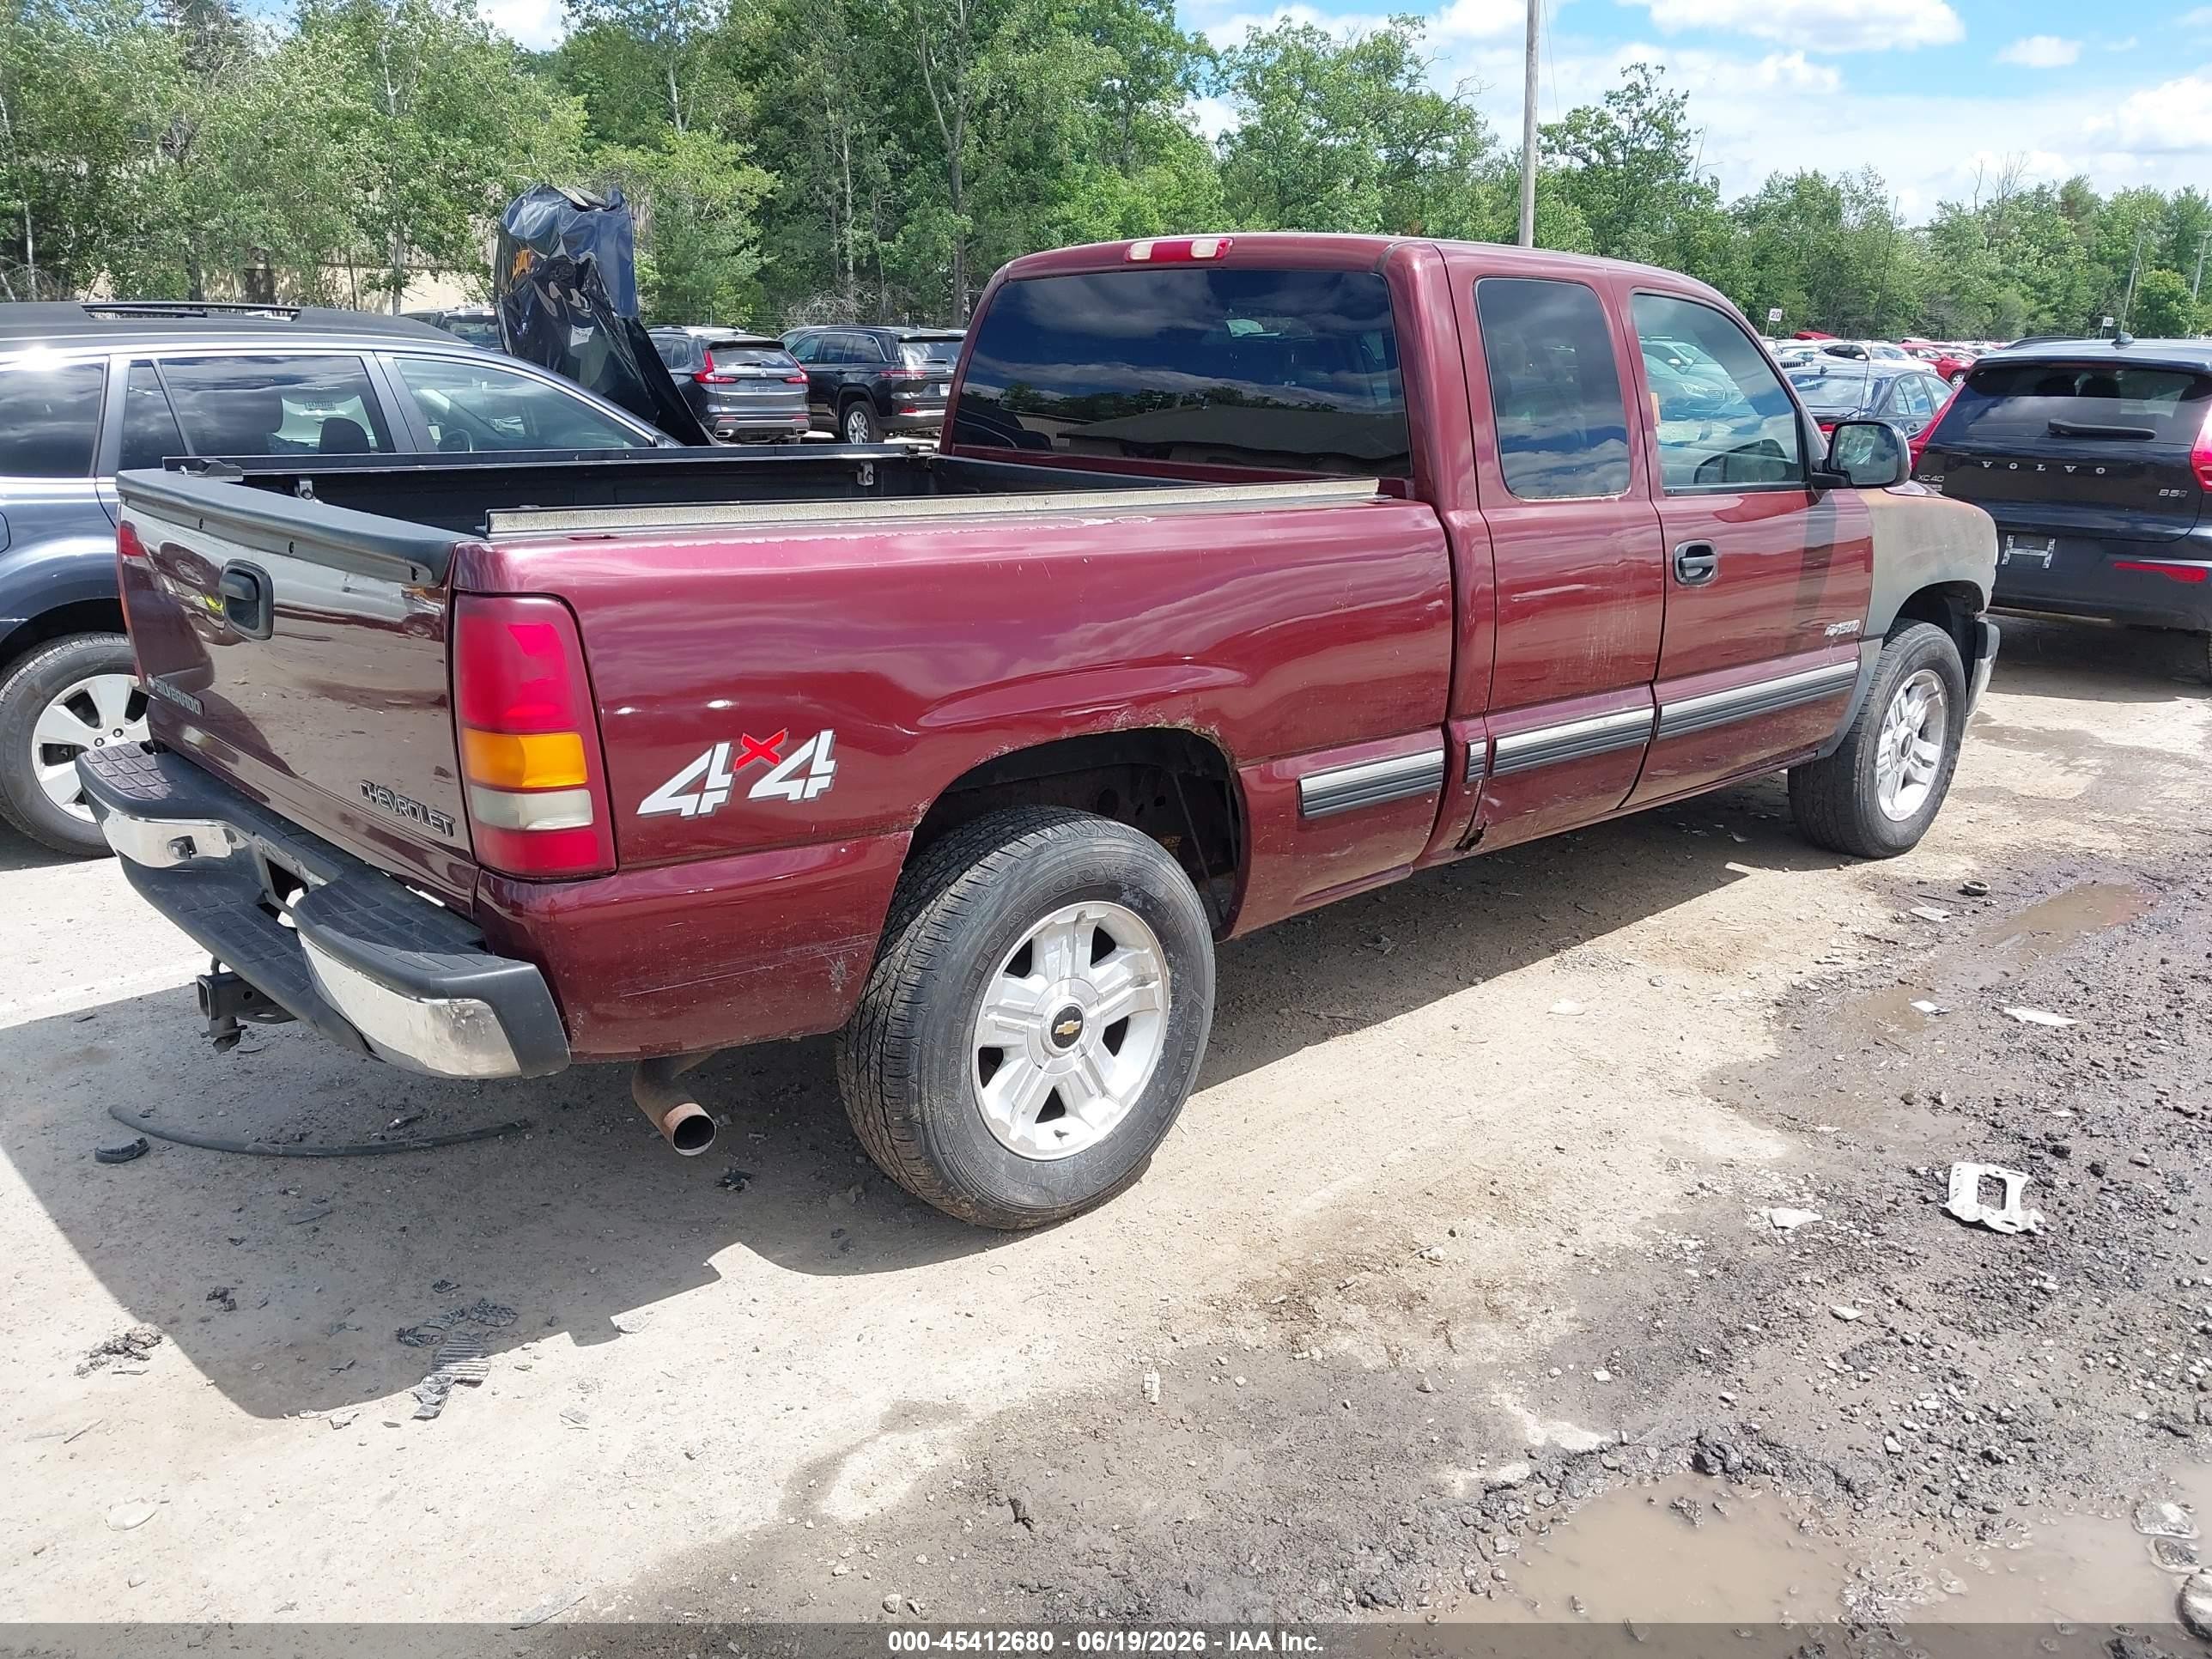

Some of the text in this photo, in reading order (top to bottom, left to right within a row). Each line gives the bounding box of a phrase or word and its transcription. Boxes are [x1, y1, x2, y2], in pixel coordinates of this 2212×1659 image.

[1917, 473, 1945, 483] XC40
[1982, 460, 2106, 475] VOLVO
[155, 678, 204, 715] SILVERADO
[360, 779, 455, 837] CHEVROLET
